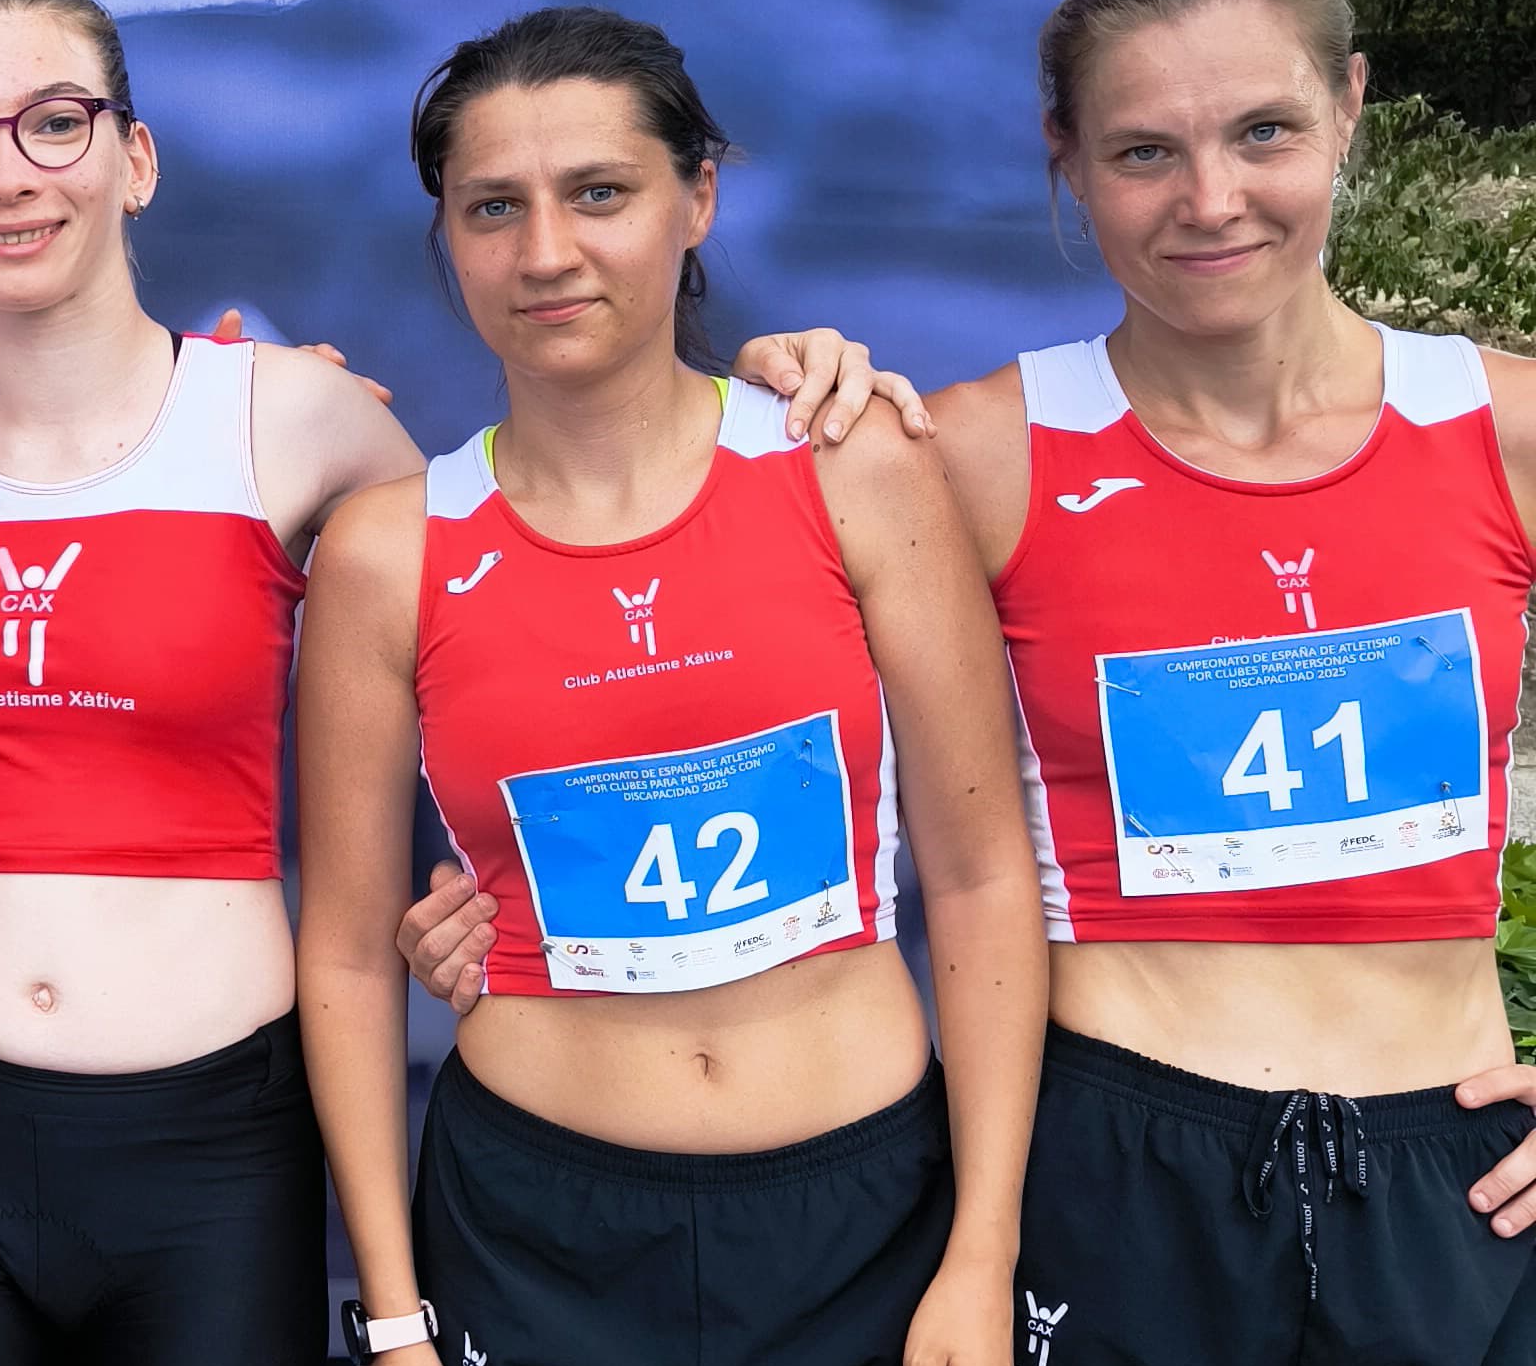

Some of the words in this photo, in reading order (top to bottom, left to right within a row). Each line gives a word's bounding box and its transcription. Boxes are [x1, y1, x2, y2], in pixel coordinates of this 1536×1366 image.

[1277, 576, 1311, 589] CAX
[0, 592, 55, 612] CAX
[624, 606, 654, 621] CAX
[1166, 656, 1249, 673] CAMPEONATO
[1252, 653, 1268, 663] DE
[1271, 646, 1317, 662] ESPAÑA
[1319, 644, 1336, 655] DE
[1338, 635, 1401, 653] ATLETISMO
[564, 673, 601, 689] Club
[605, 659, 680, 682] Atletisme
[683, 650, 734, 667] Xàtiva
[1187, 670, 1213, 682] POR
[1214, 666, 1258, 679] CLUBES
[1261, 662, 1292, 674] PARA
[1294, 654, 1356, 671] PERSONAS
[1359, 650, 1385, 662] CON
[1229, 671, 1315, 689] DISCAPACIDAD
[1317, 667, 1347, 679] 2025
[68, 691, 135, 711] Xàtiva
[565, 771, 639, 787] CAMPEONATO
[642, 769, 656, 779] DE
[658, 762, 701, 777] ESPAÑA
[703, 758, 717, 770] DE
[720, 742, 776, 766] ATLETISMO
[1221, 699, 1369, 812] 41
[585, 784, 608, 795] POR
[610, 779, 648, 792] CLUBES
[650, 777, 678, 789] PARA
[681, 766, 736, 784] PERSONAS
[738, 759, 761, 773] CON
[623, 786, 700, 801] DISCAPACIDAD
[1350, 834, 1376, 845] FEDC
[623, 811, 769, 921] 42
[1027, 1319, 1054, 1337] CAX
